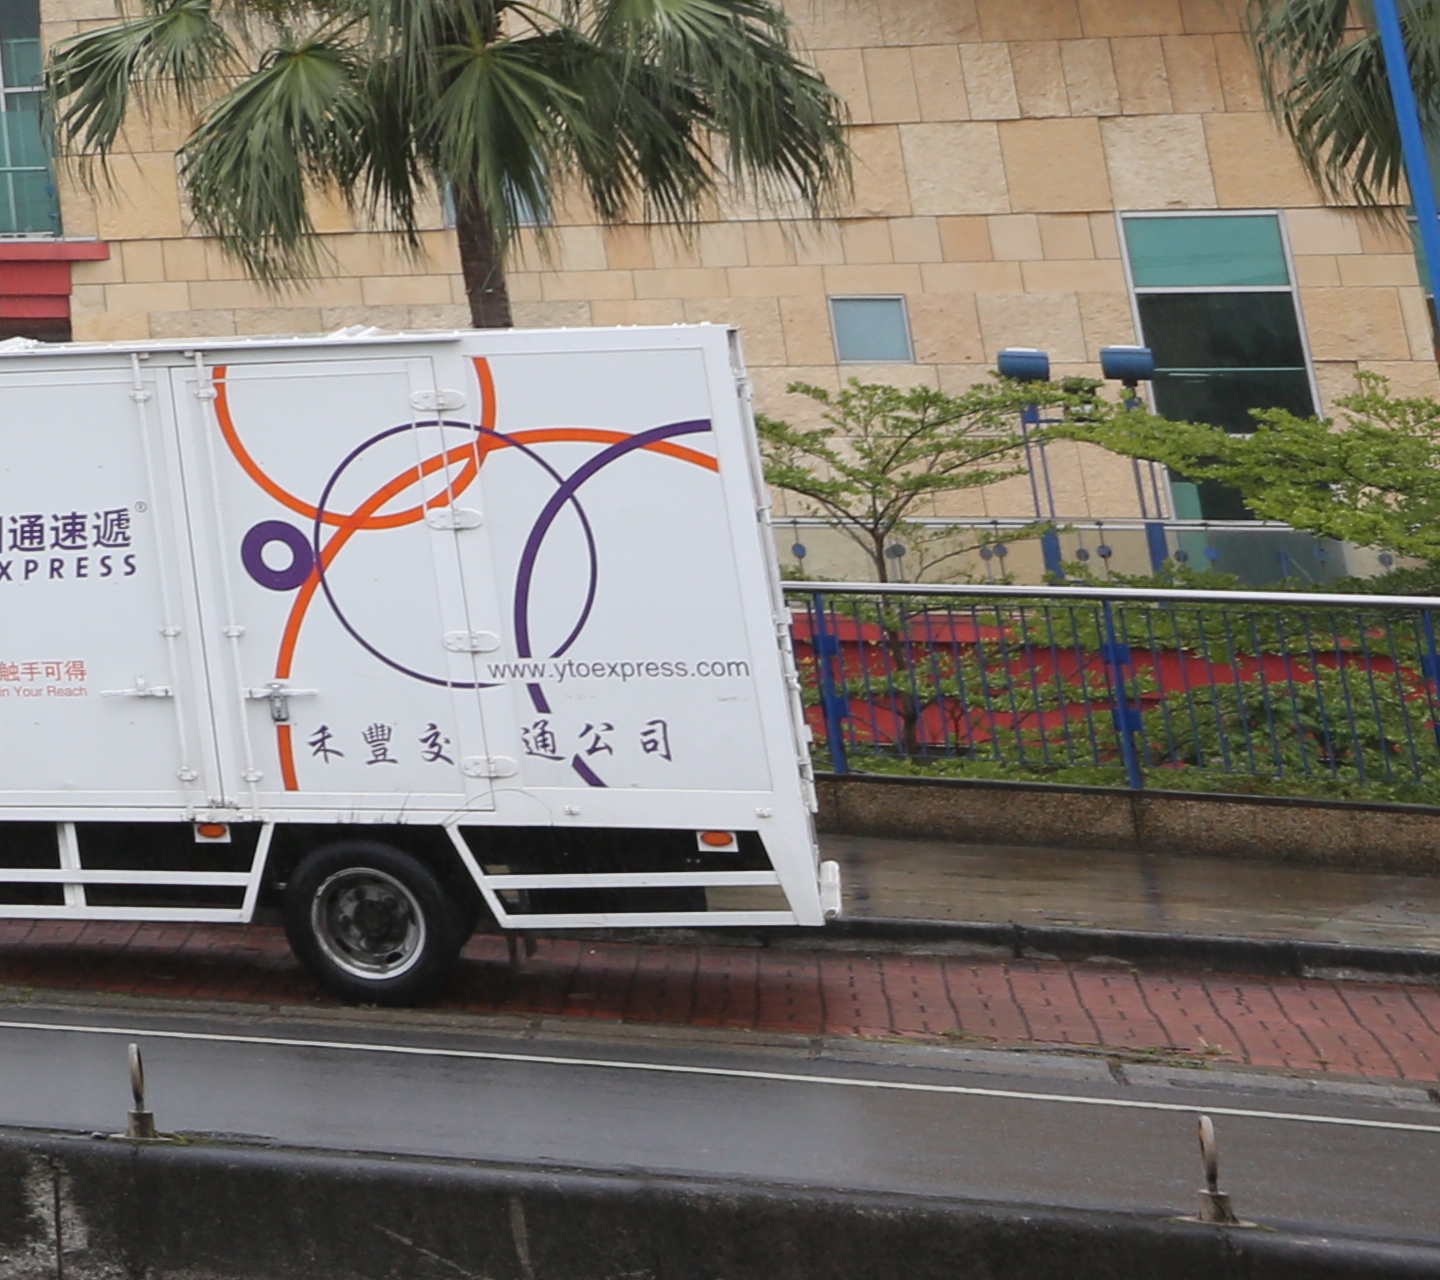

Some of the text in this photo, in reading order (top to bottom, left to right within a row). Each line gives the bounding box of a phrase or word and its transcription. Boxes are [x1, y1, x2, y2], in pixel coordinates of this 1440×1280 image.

[486, 656, 751, 684] www.ytoexpress.com
[15, 686, 43, 698] Your
[46, 685, 88, 697] Reach
